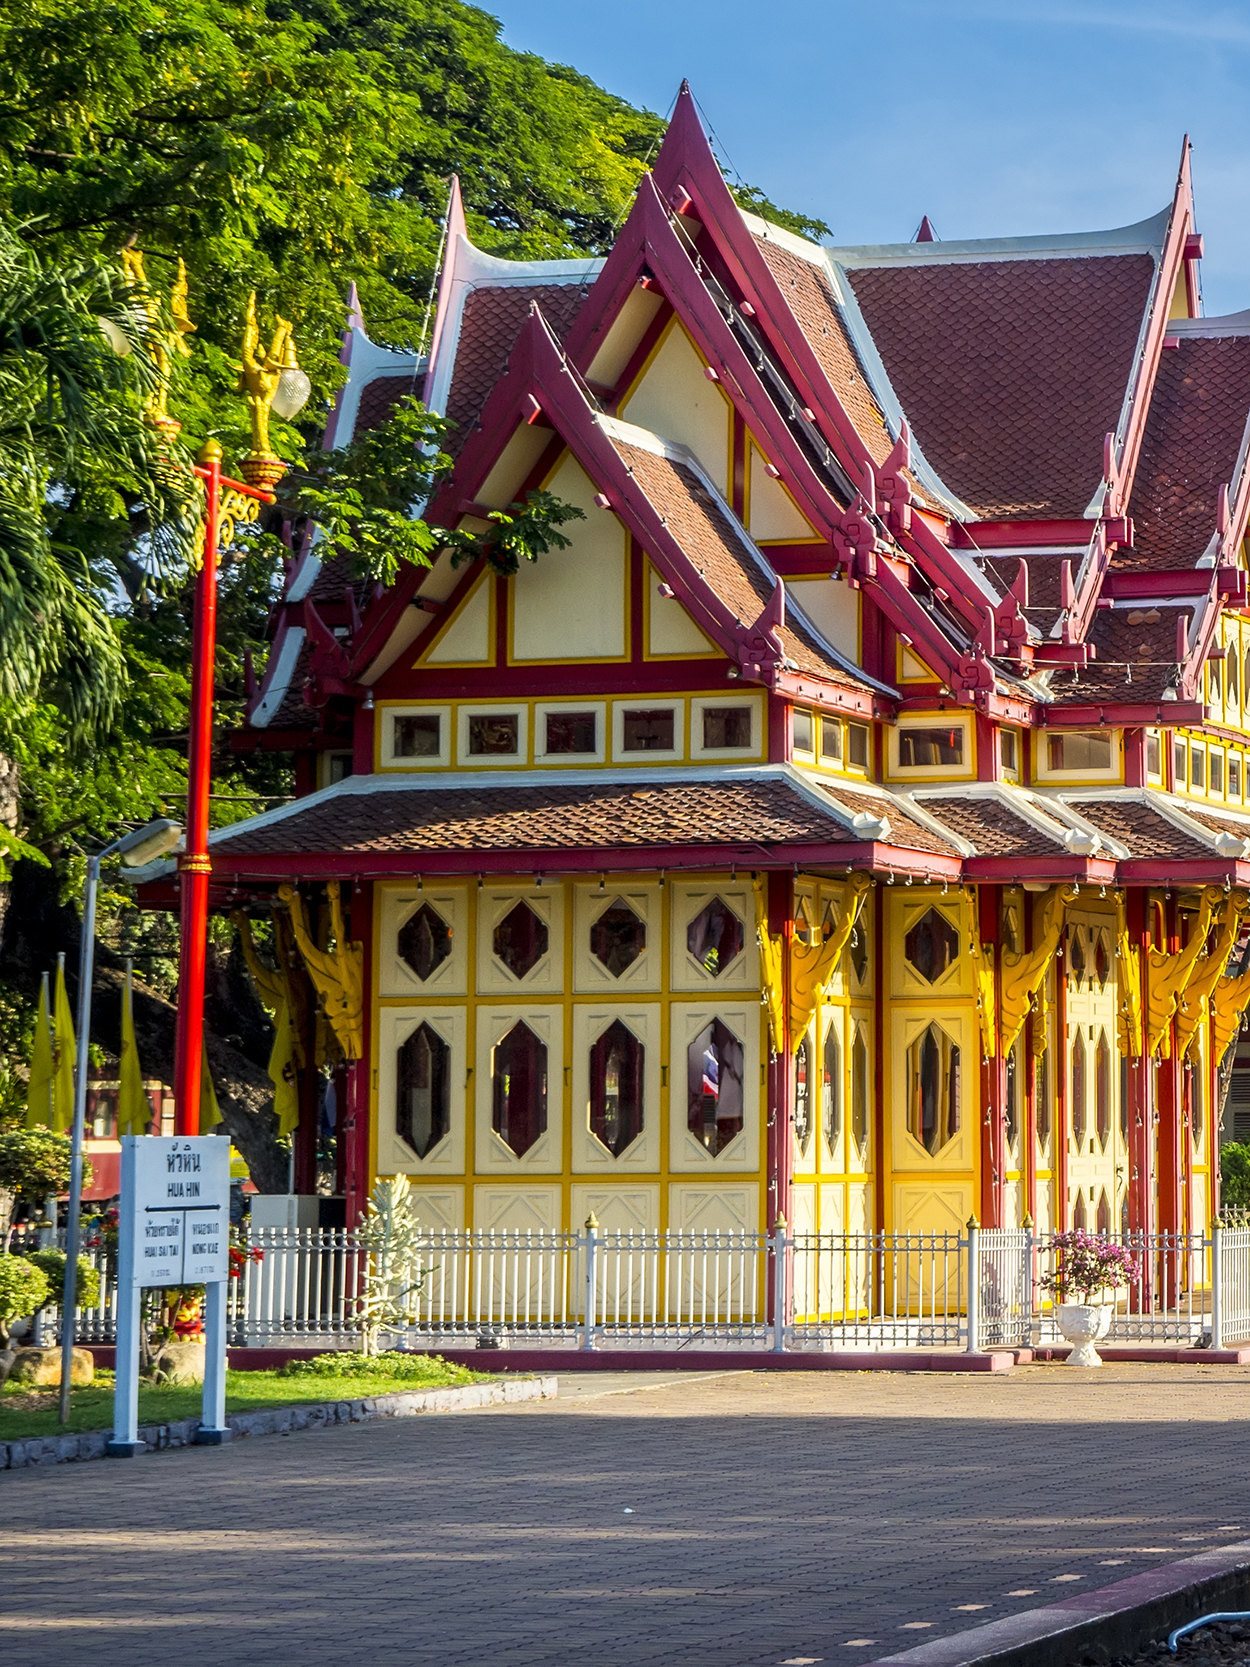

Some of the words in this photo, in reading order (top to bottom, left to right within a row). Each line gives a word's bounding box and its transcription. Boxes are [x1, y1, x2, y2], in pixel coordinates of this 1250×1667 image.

[167, 1142, 201, 1172] หัวหิน
[168, 1183, 184, 1197] HUA
[186, 1182, 200, 1197] HIN
